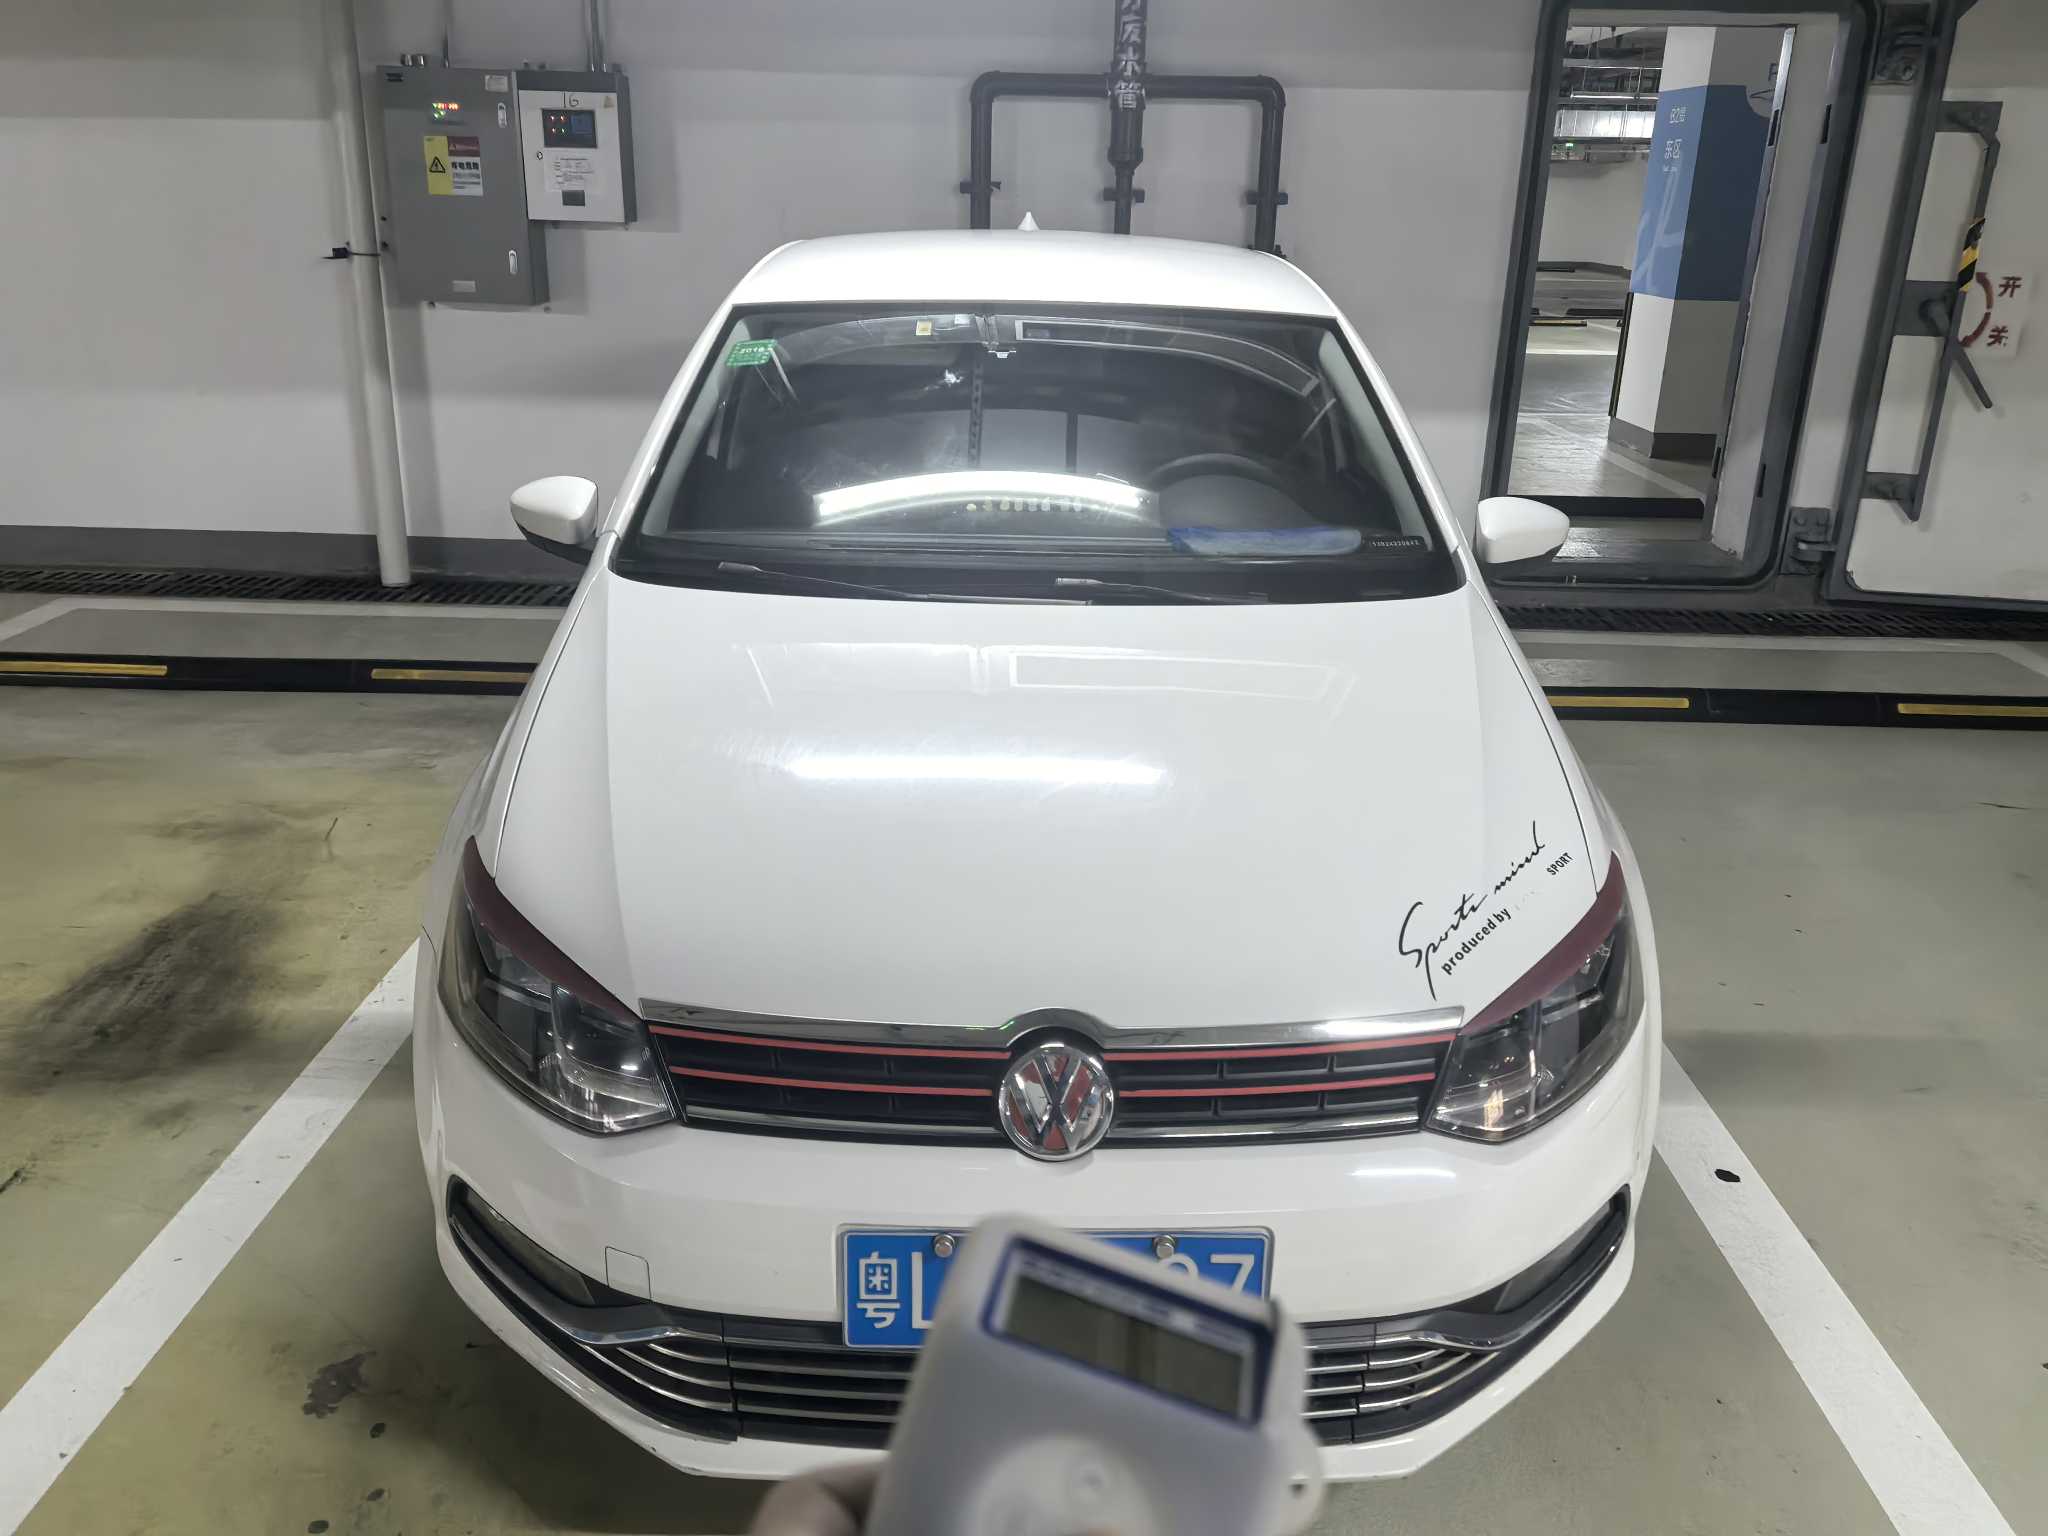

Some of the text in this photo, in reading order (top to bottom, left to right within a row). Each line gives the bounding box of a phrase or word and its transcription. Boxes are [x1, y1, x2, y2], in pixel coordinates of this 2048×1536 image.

[1998, 275, 2022, 298] 开
[1986, 325, 2009, 347] 关
[1494, 819, 1546, 895] mind
[1441, 851, 1574, 975] produced by SPORT
